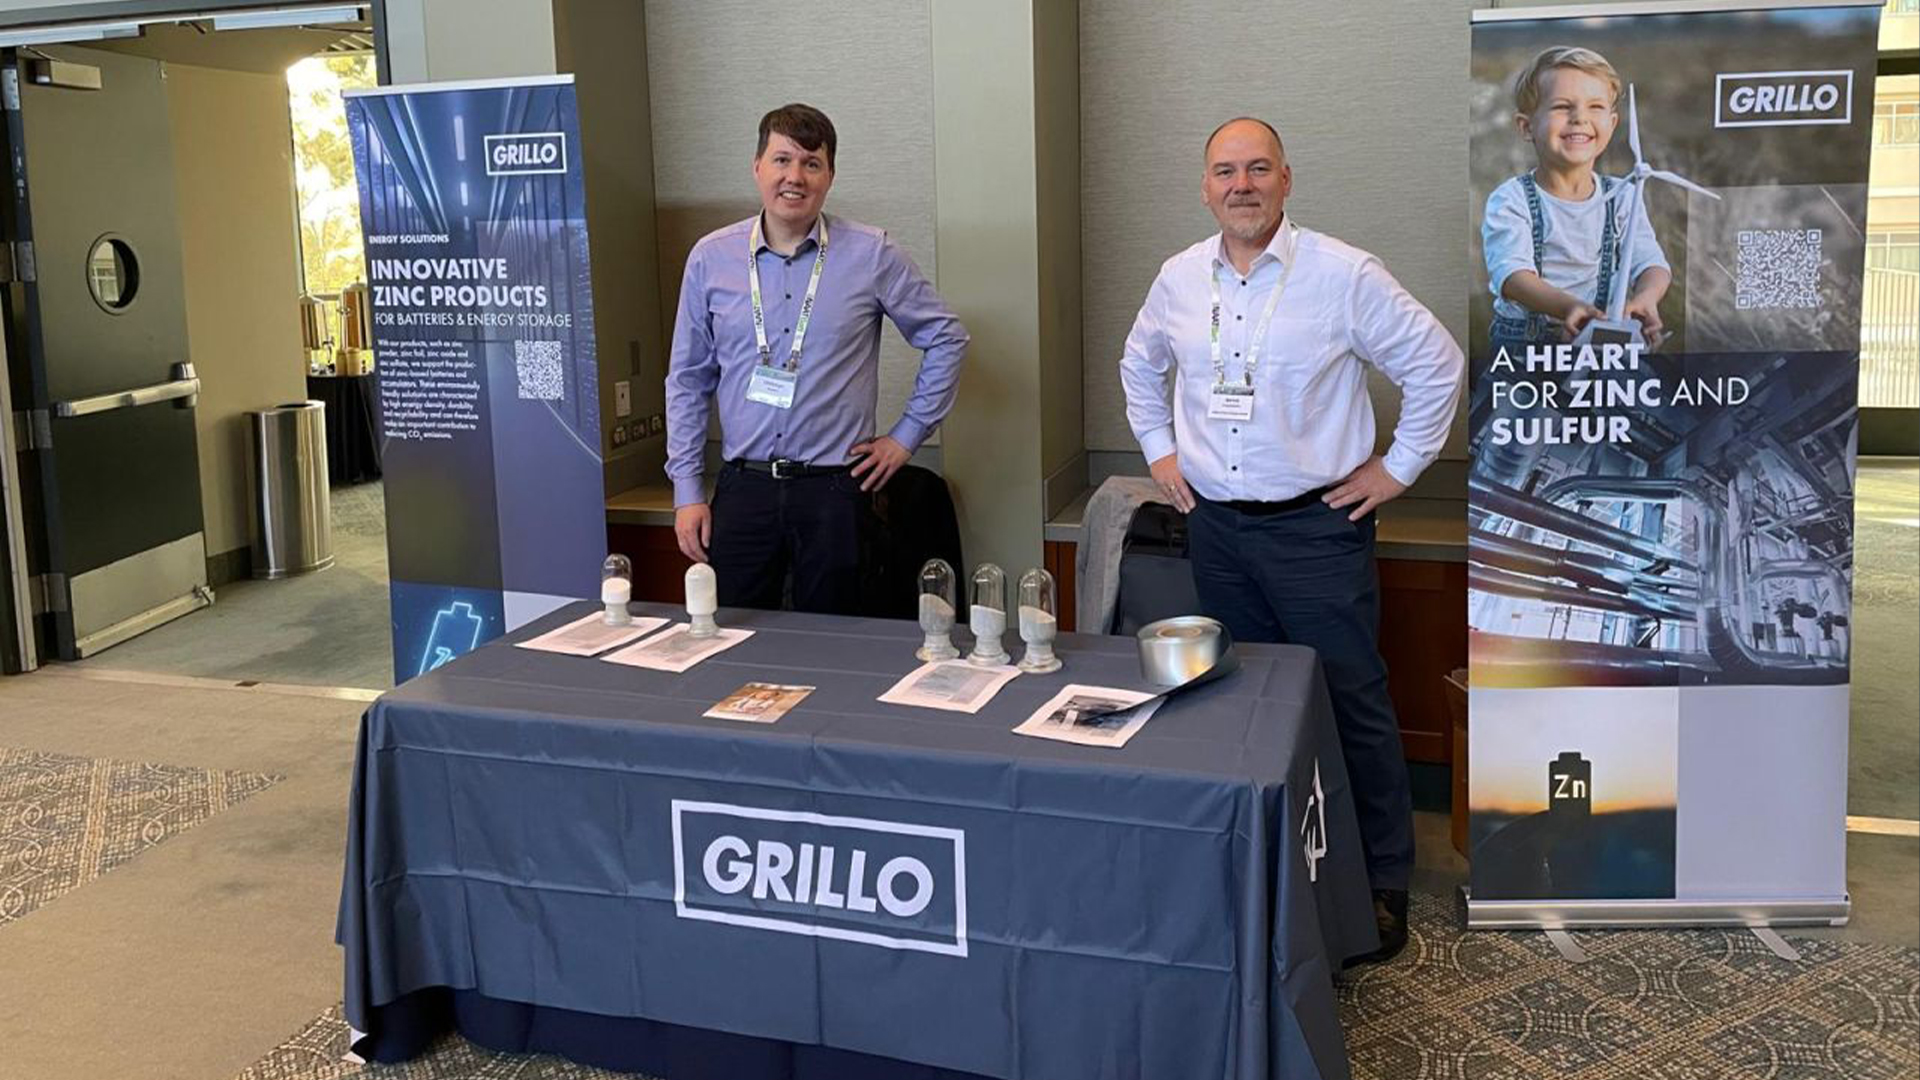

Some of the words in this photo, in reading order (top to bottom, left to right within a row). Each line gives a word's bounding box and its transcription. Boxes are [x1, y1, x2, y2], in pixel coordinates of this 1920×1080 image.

[1729, 84, 1839, 114] GRILLO
[493, 142, 557, 165] GRILLO
[369, 236, 398, 244] ENERGY
[400, 234, 449, 244] SOLUTIONS
[371, 258, 508, 280] INNOVATIVE
[374, 286, 424, 306] ZINC
[431, 286, 547, 307] PRODUCTS
[376, 312, 394, 325] FOR
[398, 312, 452, 326] BATTERIES
[457, 313, 465, 326] &
[468, 314, 514, 326] ENERGY
[518, 314, 572, 327] STORAGE
[1490, 346, 1515, 373] A
[1526, 343, 1644, 372] HEART
[1492, 381, 1558, 410] FOR
[1568, 378, 1662, 408] ZINC
[1670, 377, 1750, 407] AND
[1492, 416, 1632, 445] SULFUR
[1554, 774, 1586, 798] Zn
[702, 835, 934, 917] GRILLO
